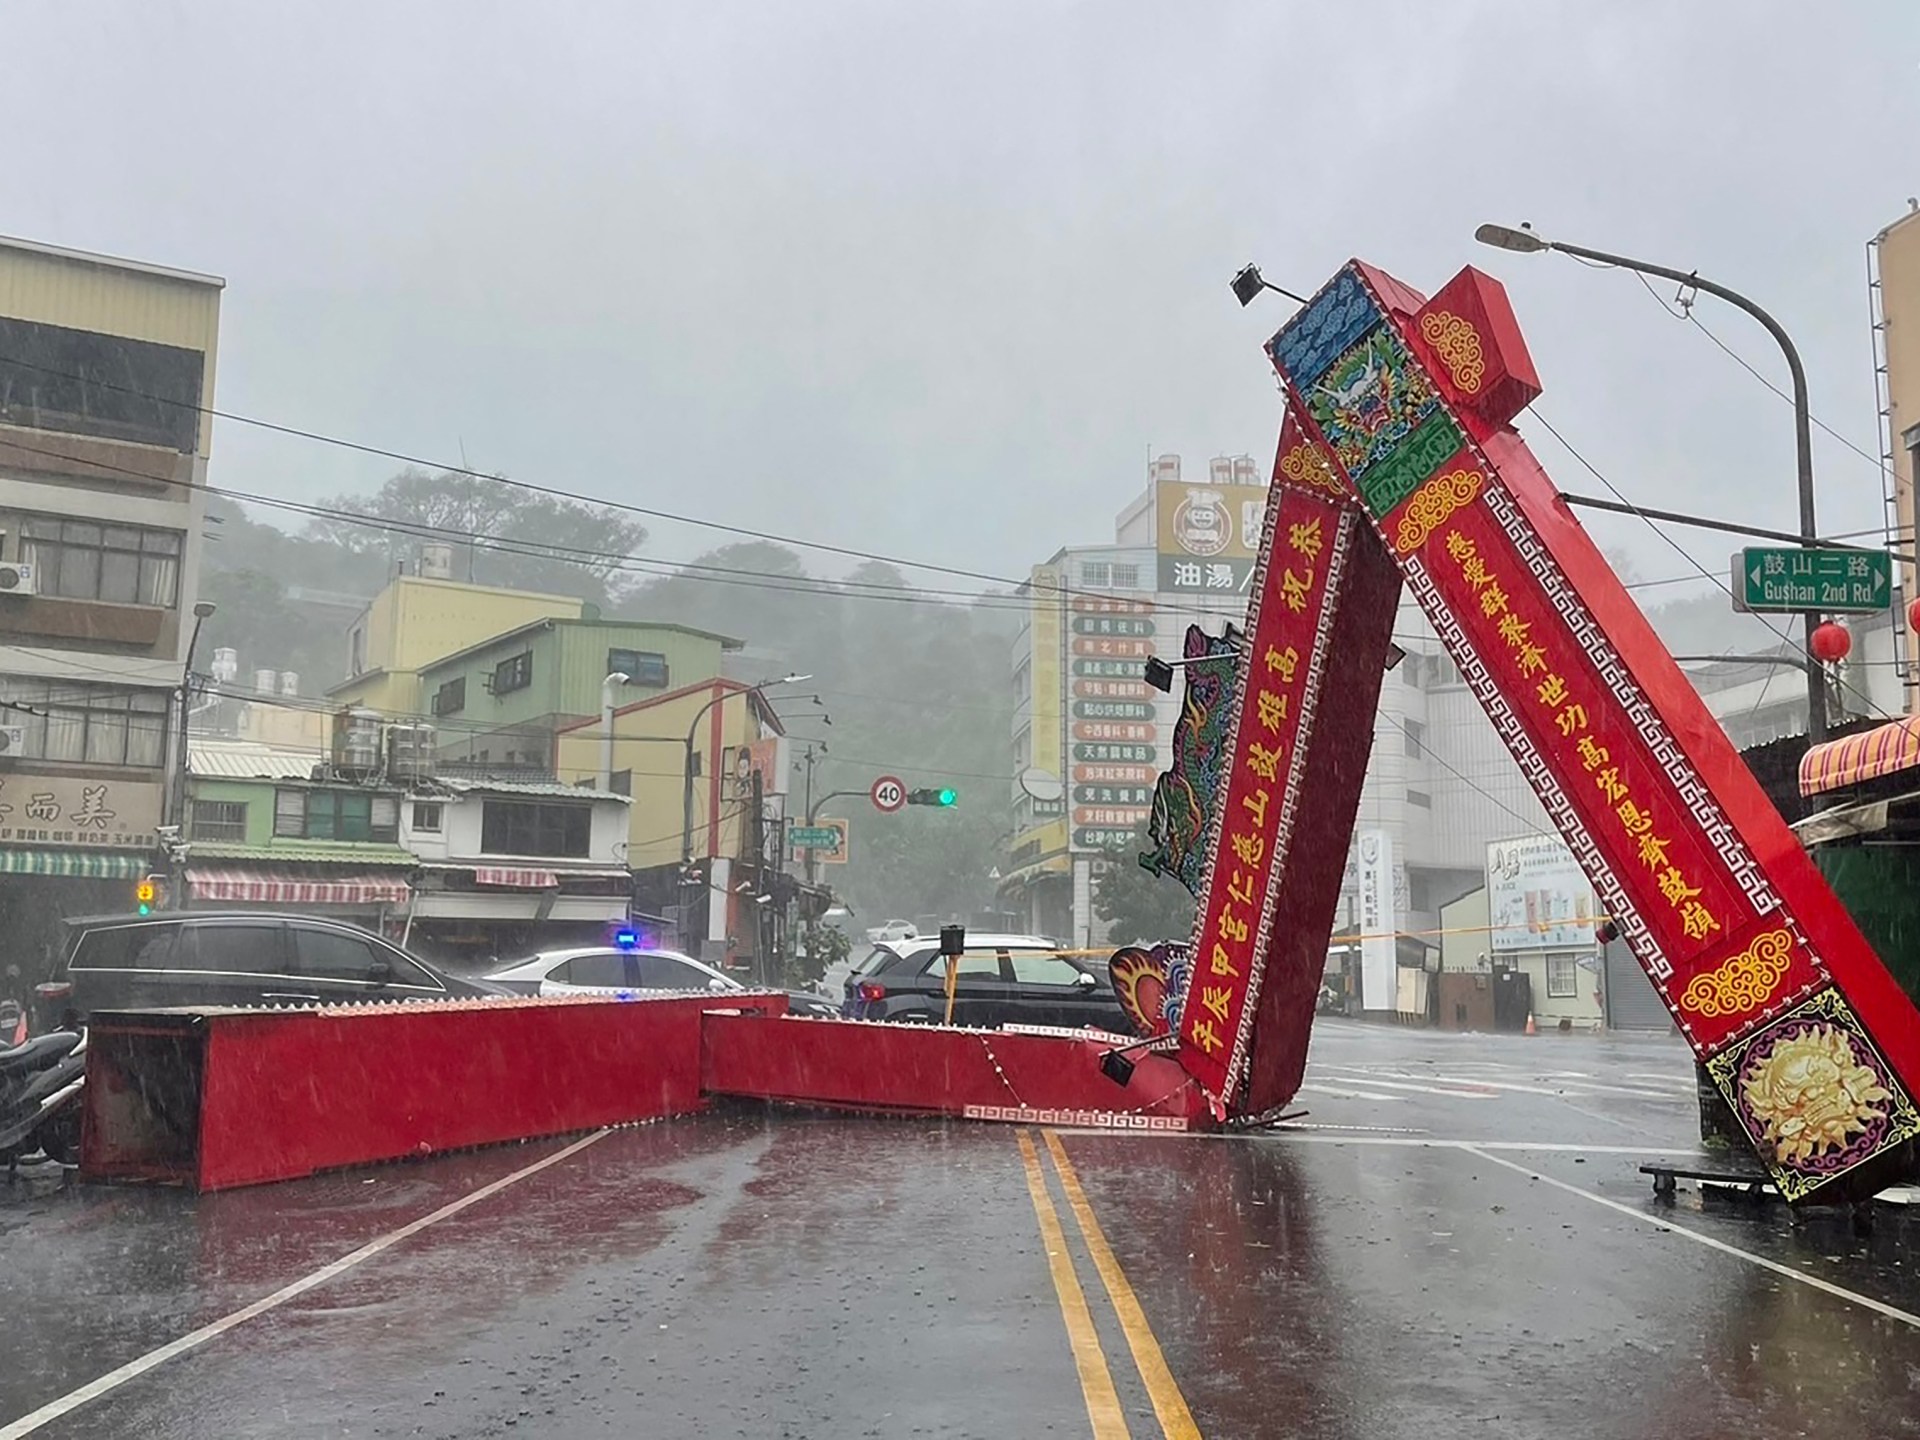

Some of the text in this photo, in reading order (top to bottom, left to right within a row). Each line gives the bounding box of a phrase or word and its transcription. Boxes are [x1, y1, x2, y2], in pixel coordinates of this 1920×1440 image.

[1763, 553, 1871, 577] 鼓山二路
[1764, 580, 1816, 601] Gushan
[1821, 581, 1847, 602] 2nd
[0, 779, 116, 829] 而美
[878, 786, 900, 802] 40
